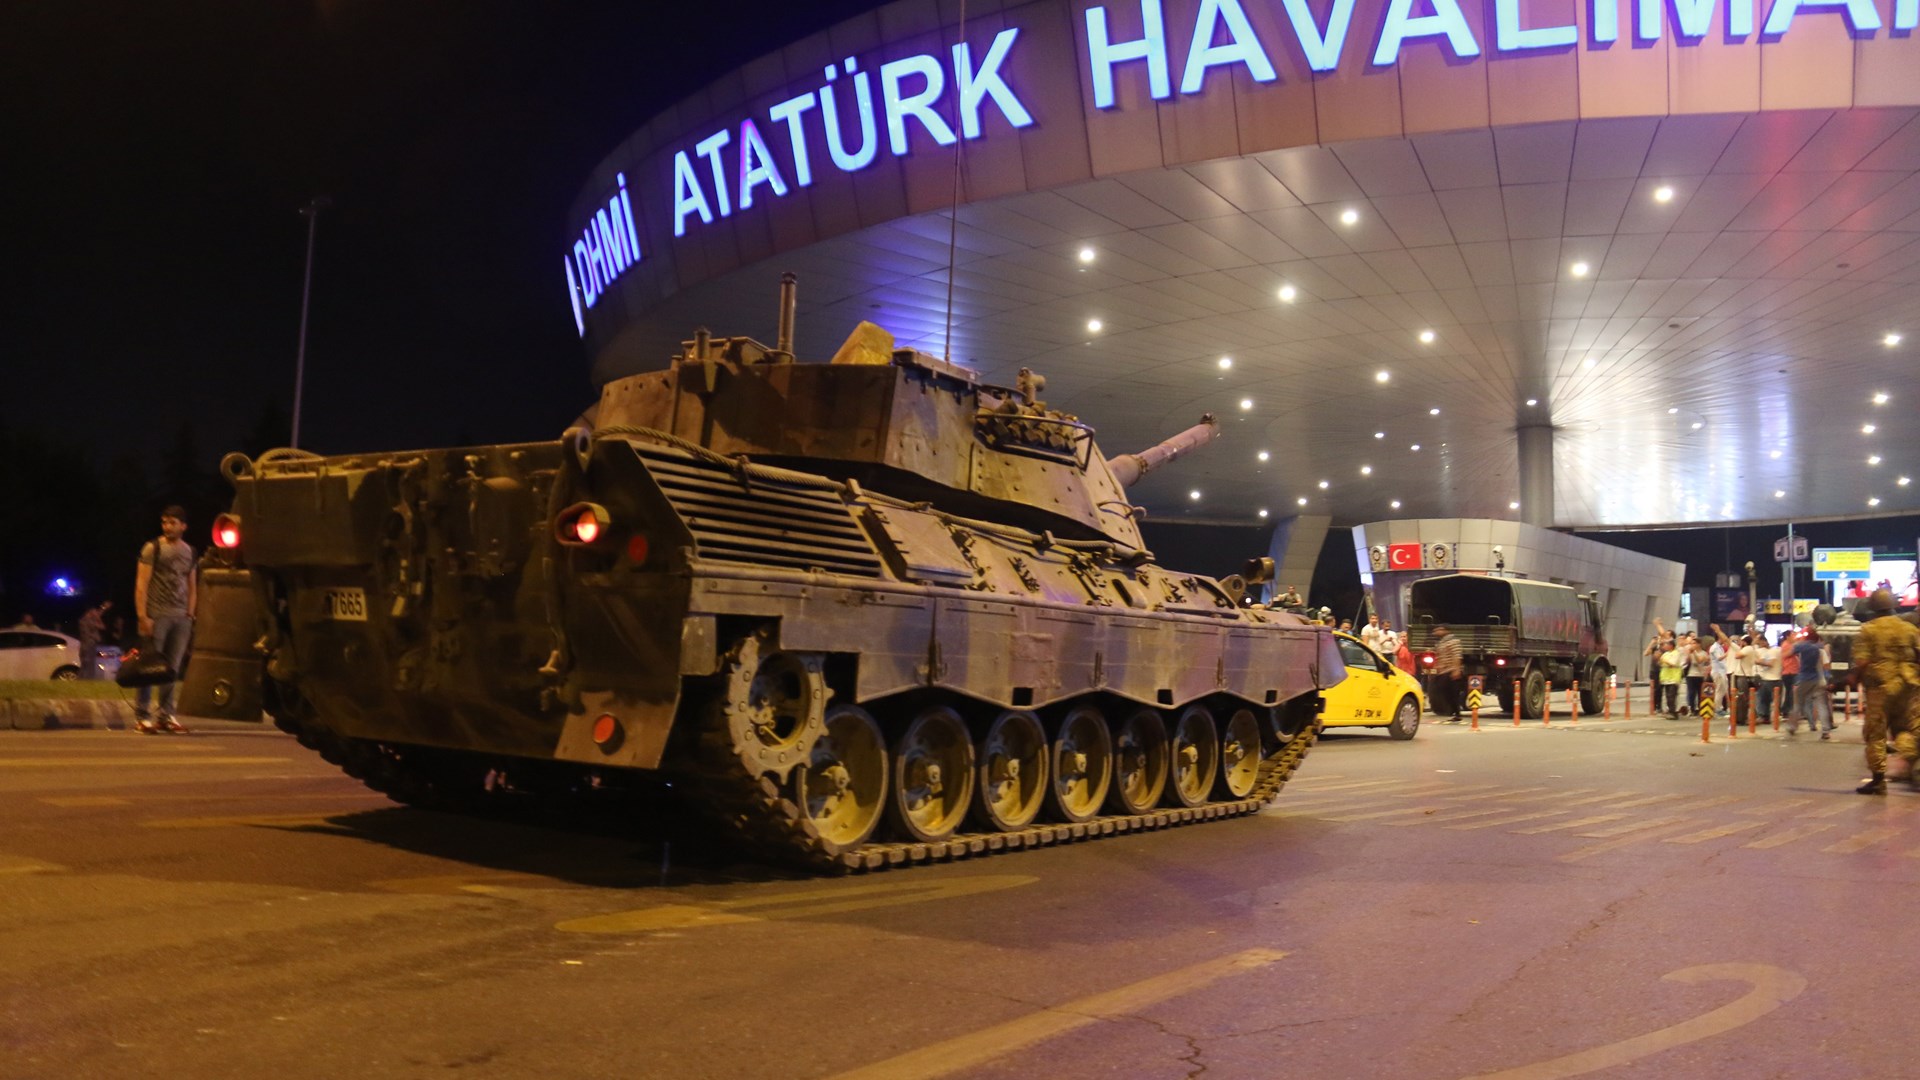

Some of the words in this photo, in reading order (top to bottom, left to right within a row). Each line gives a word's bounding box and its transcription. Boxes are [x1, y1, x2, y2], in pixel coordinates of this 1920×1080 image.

[573, 172, 641, 309] DHMİ
[673, 27, 1034, 238] ATATÜRK
[331, 592, 363, 616] 7665
